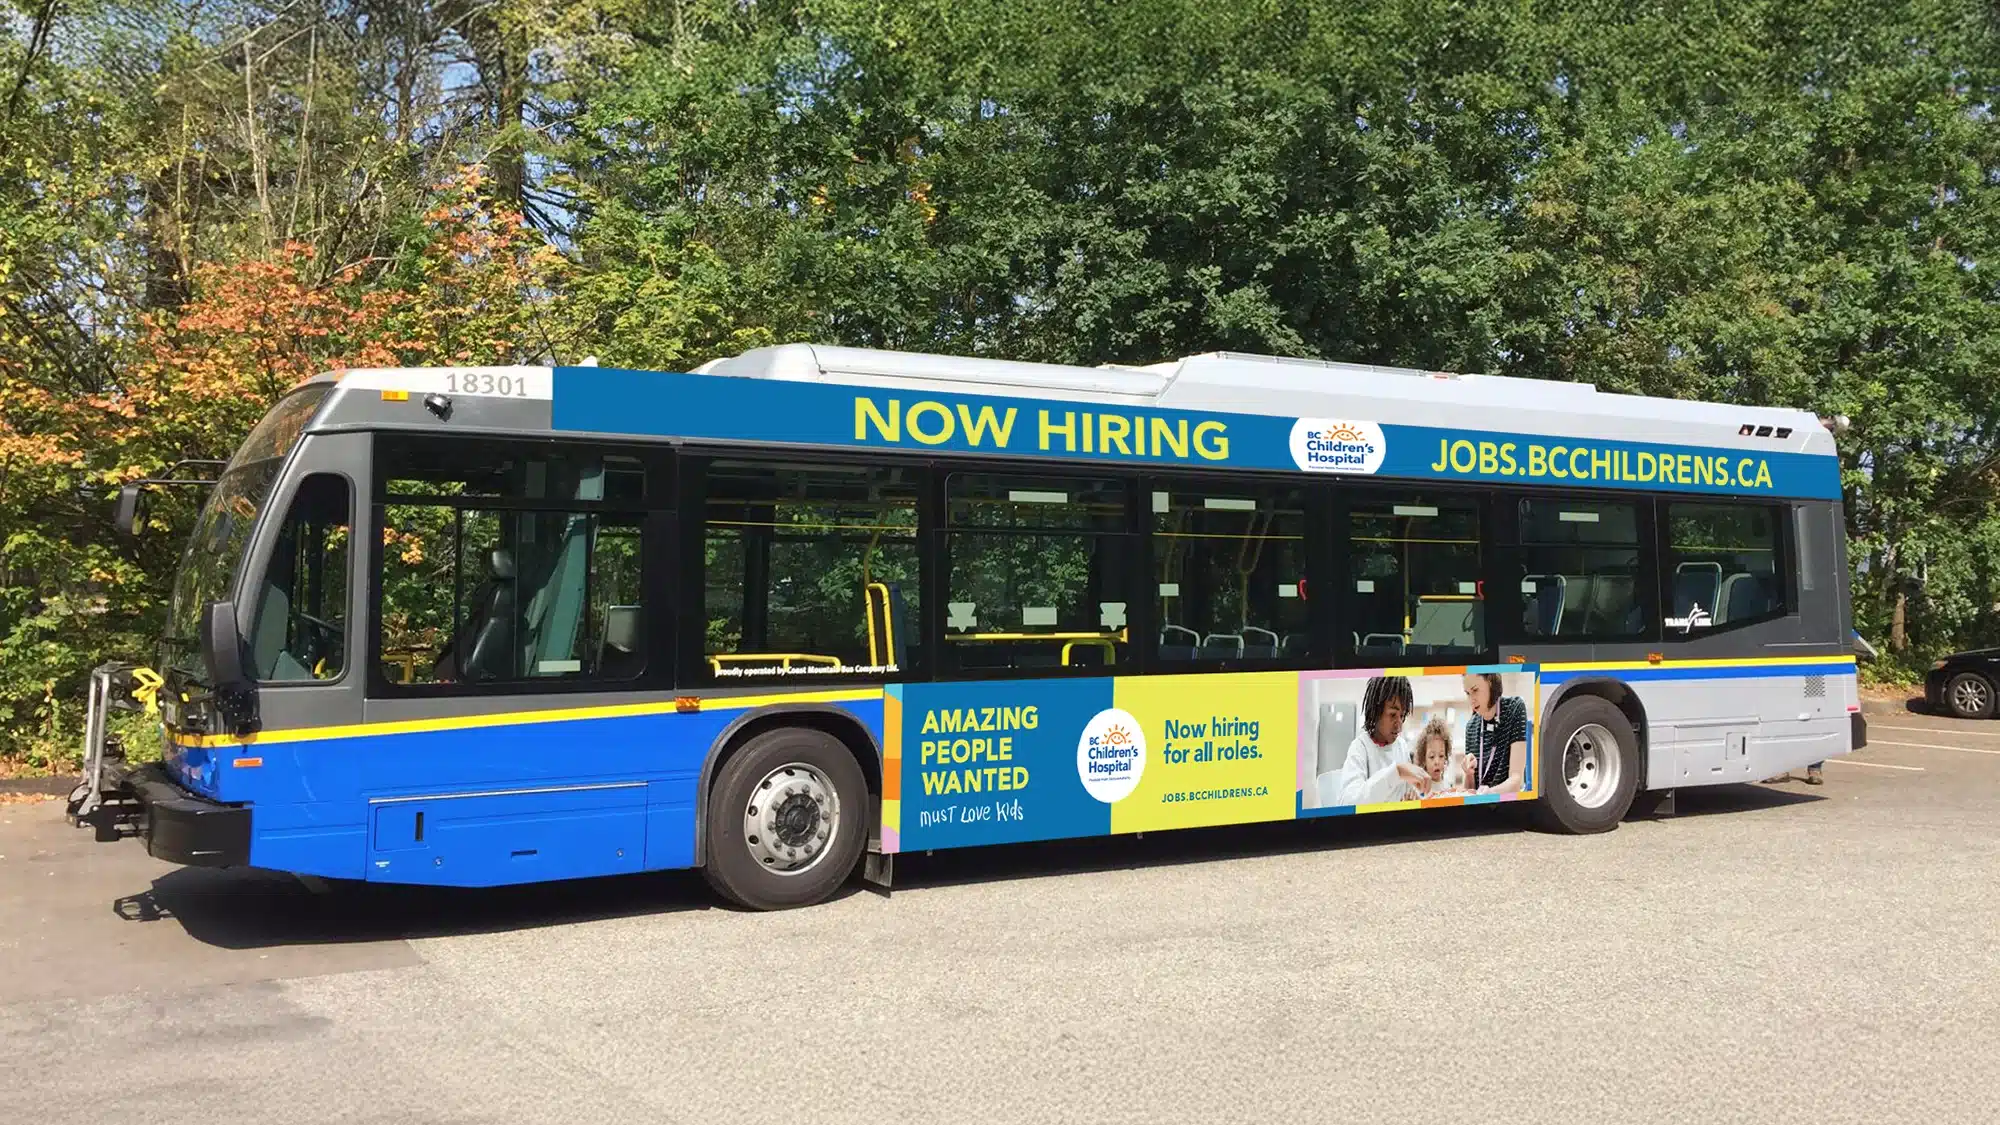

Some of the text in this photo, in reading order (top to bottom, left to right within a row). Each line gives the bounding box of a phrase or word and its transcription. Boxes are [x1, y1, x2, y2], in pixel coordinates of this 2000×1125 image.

[446, 372, 527, 397] 18301
[854, 397, 1229, 460] NOW HIRING
[1307, 431, 1321, 439] BC
[1306, 440, 1374, 454] Children's
[1308, 451, 1365, 465] Hospital
[1431, 438, 1773, 488] JOBS.BCCHILDRENS.CA
[743, 666, 776, 677] operated
[777, 665, 786, 676] by
[787, 666, 806, 675] Coast
[841, 665, 855, 673] Bus
[855, 664, 886, 674] Company
[920, 706, 1039, 734] AMAZING
[1165, 716, 1259, 741] Now hiring
[921, 737, 1012, 765] PEOPLE
[1089, 737, 1099, 745] BC
[1088, 745, 1138, 760] Children's
[1164, 740, 1262, 764] for all roles.
[1088, 758, 1131, 775] Hospital
[921, 766, 1029, 795] WANTED
[1162, 786, 1268, 803] JOBS.BCCHILDRENS.CA
